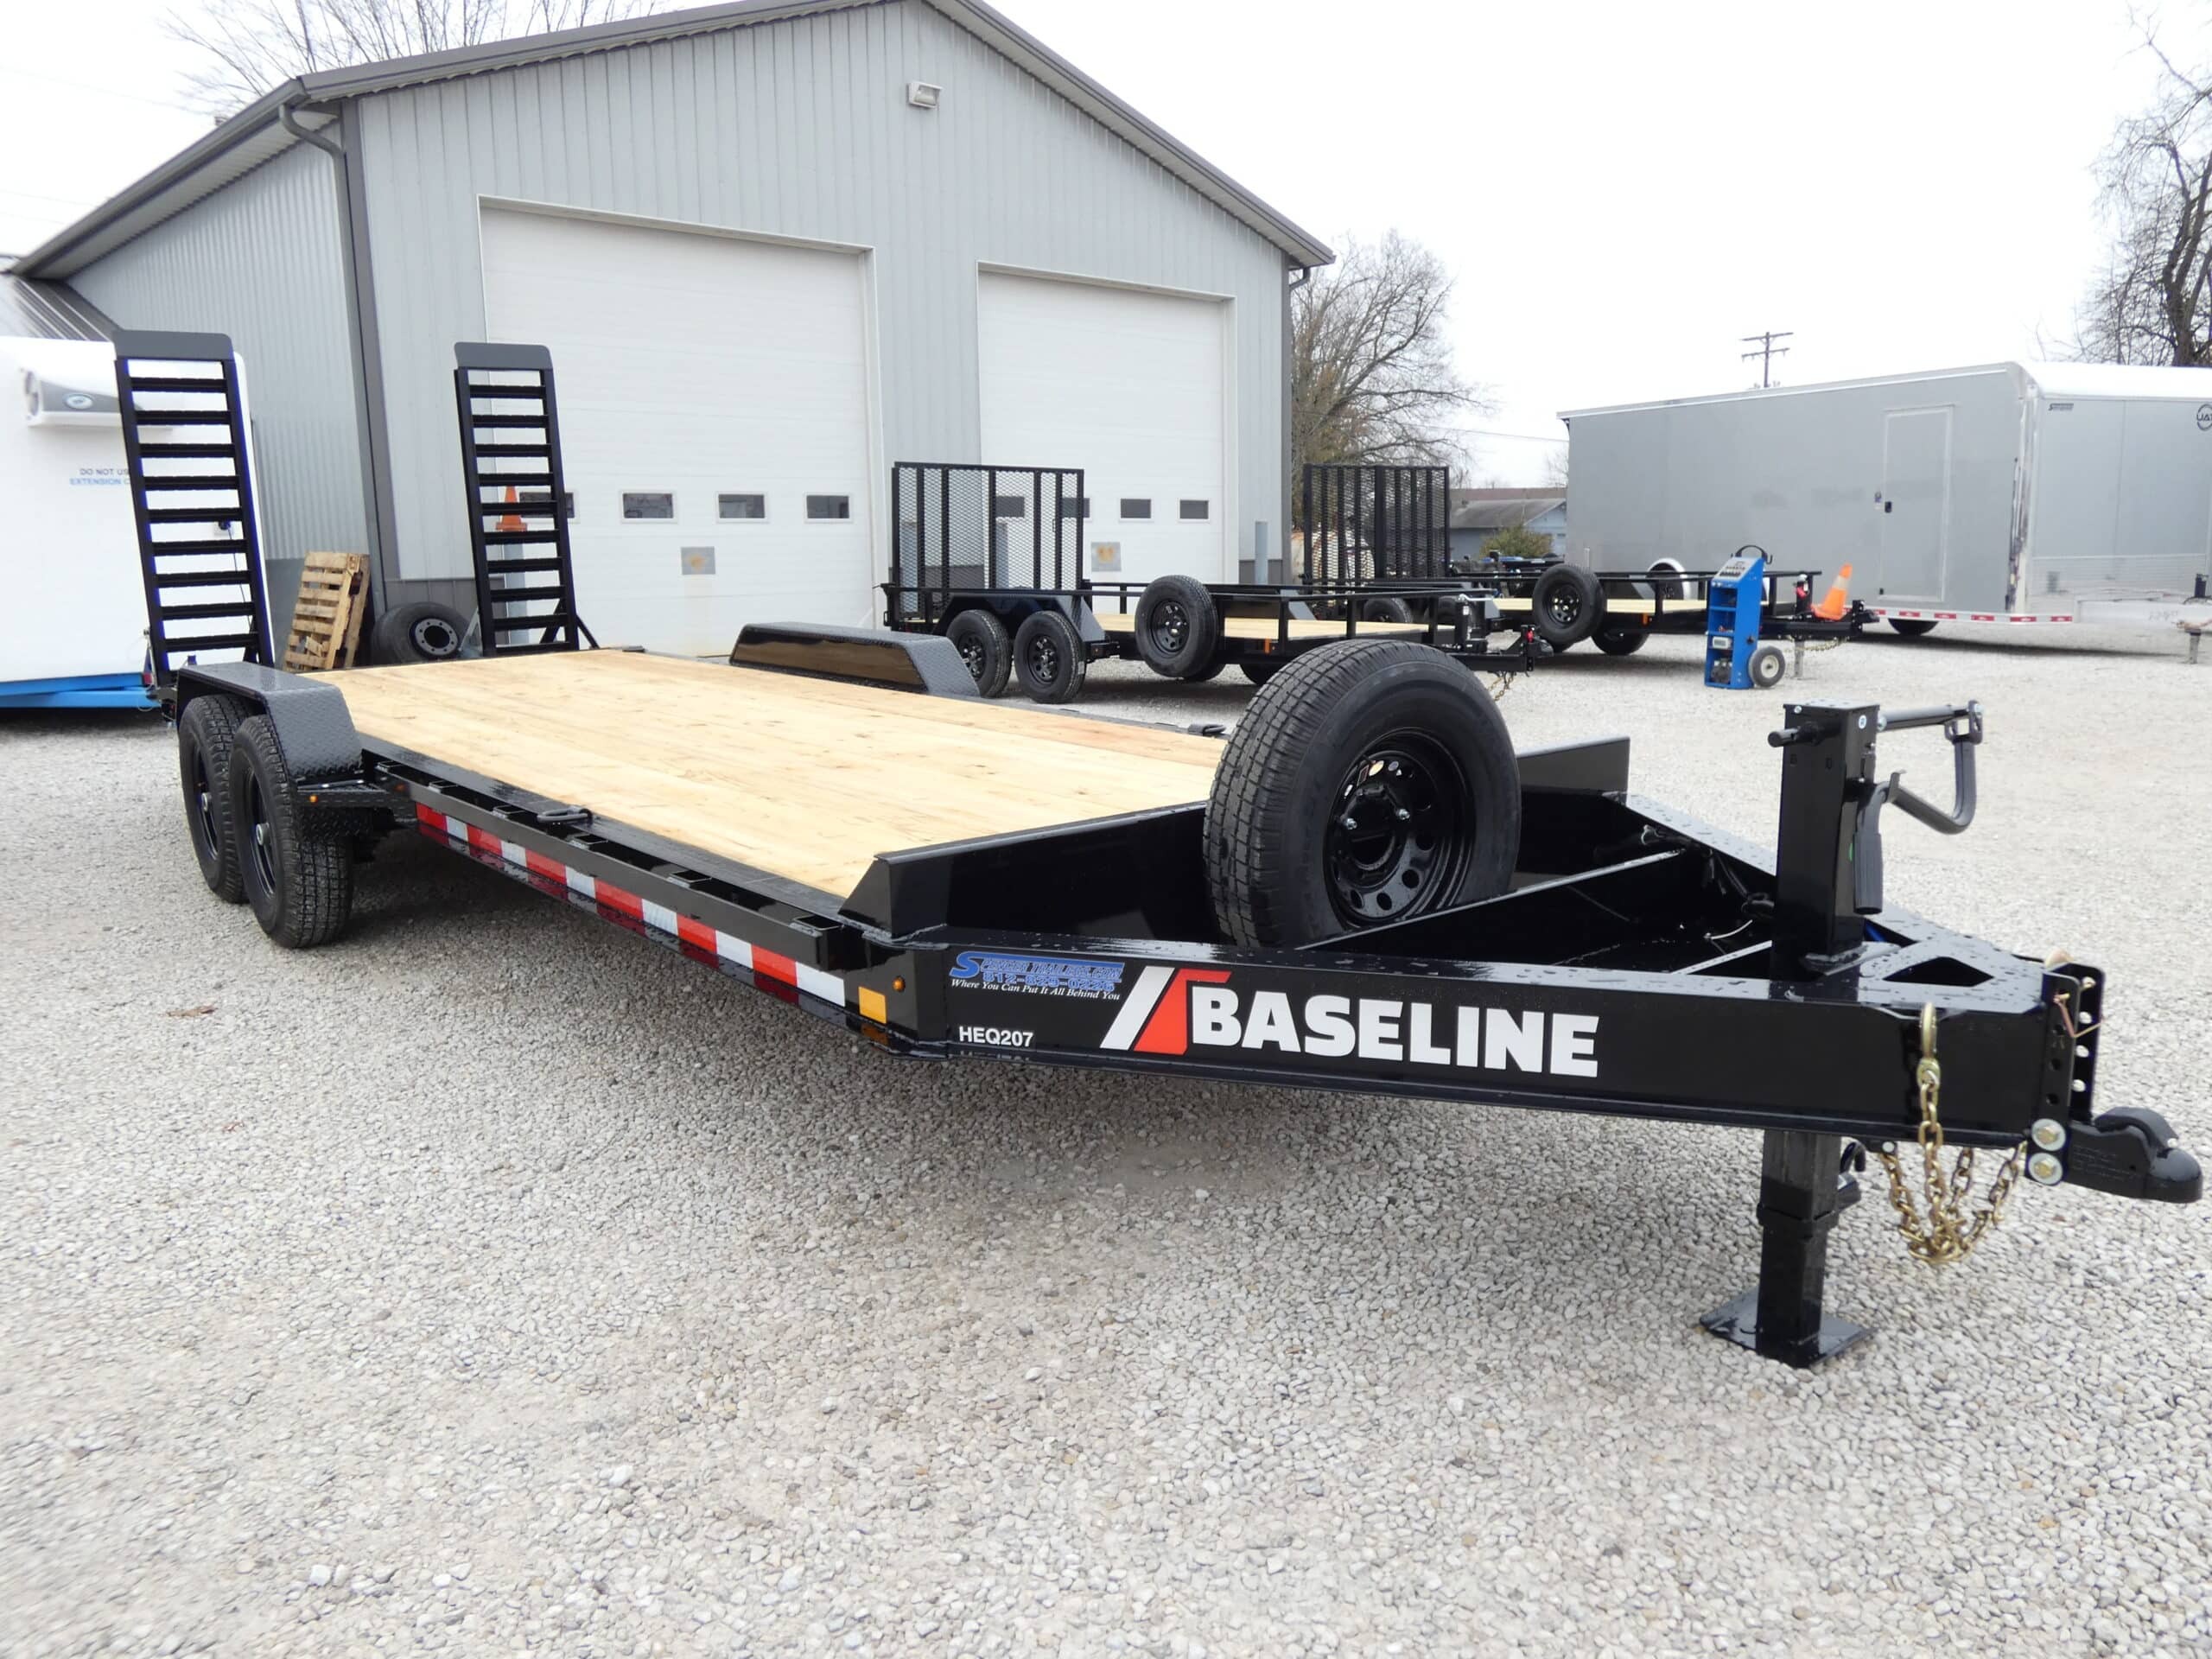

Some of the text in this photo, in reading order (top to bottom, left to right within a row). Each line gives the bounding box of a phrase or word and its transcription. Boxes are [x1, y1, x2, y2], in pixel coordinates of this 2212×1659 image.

[951, 978, 979, 989] Where
[982, 981, 999, 991] You
[1001, 983, 1020, 993] Can
[1022, 984, 1038, 994] Put
[1050, 987, 1065, 996] All
[1067, 988, 1099, 999] Behind
[1102, 991, 1120, 1001] You
[958, 1025, 1034, 1047] HEQ207
[1192, 985, 1599, 1077] BASELINE
